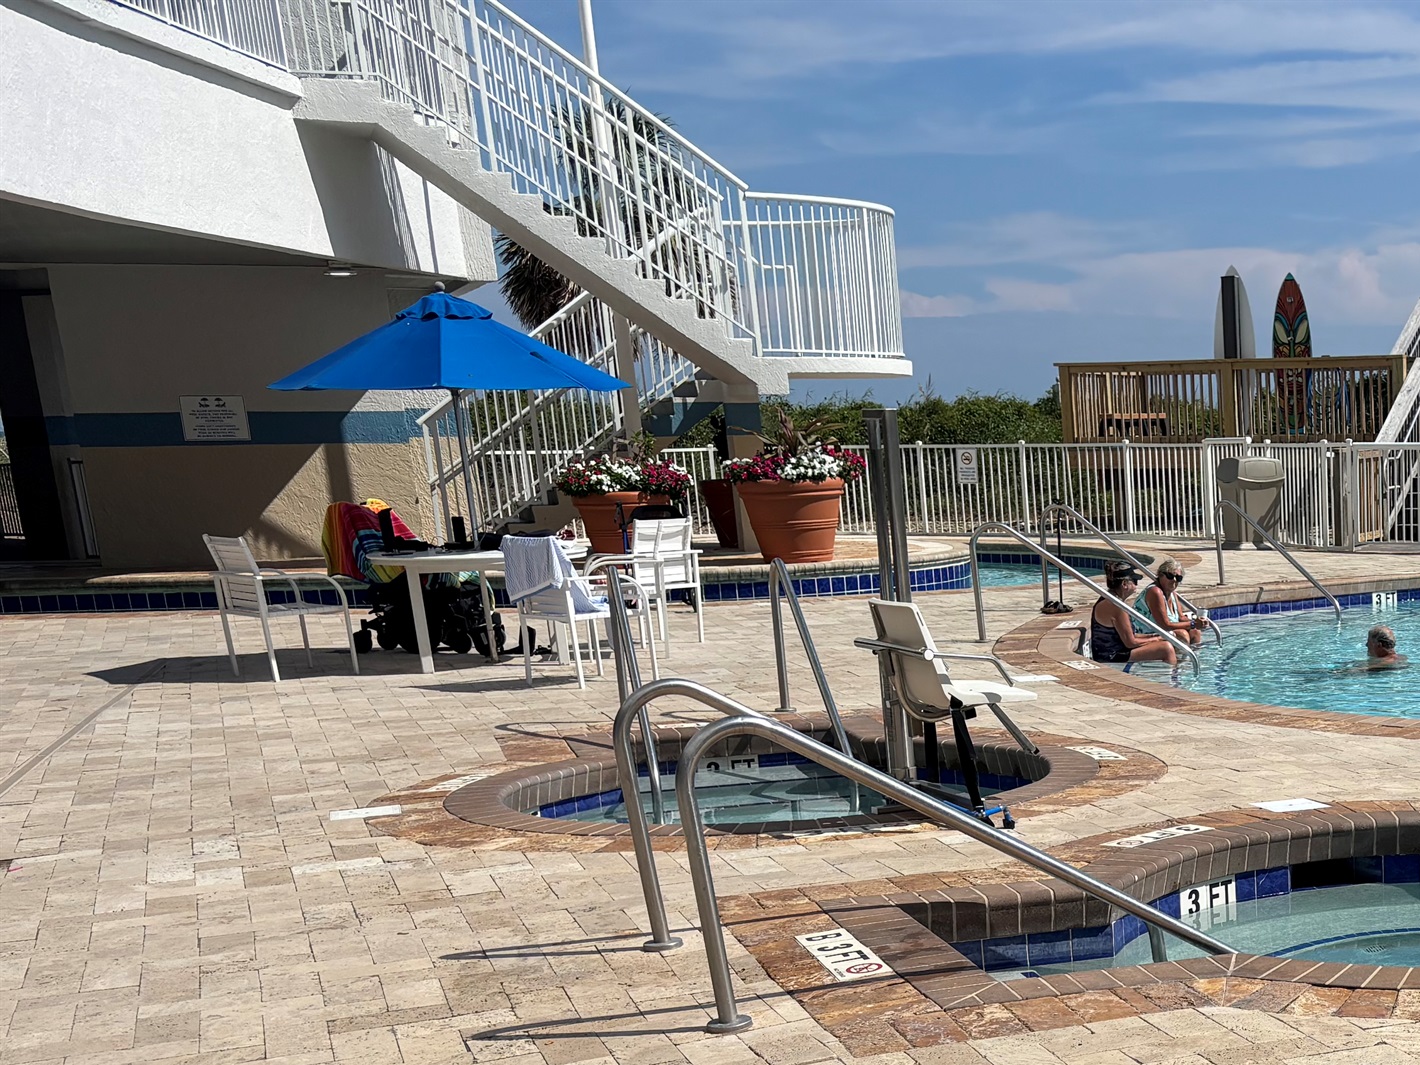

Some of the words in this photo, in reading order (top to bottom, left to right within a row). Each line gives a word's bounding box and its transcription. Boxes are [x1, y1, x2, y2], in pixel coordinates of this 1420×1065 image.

[1385, 591, 1396, 609] FT
[1188, 888, 1201, 914] 3
[1209, 879, 1233, 908] FT
[816, 943, 854, 952] 3
[824, 949, 871, 964] FT
